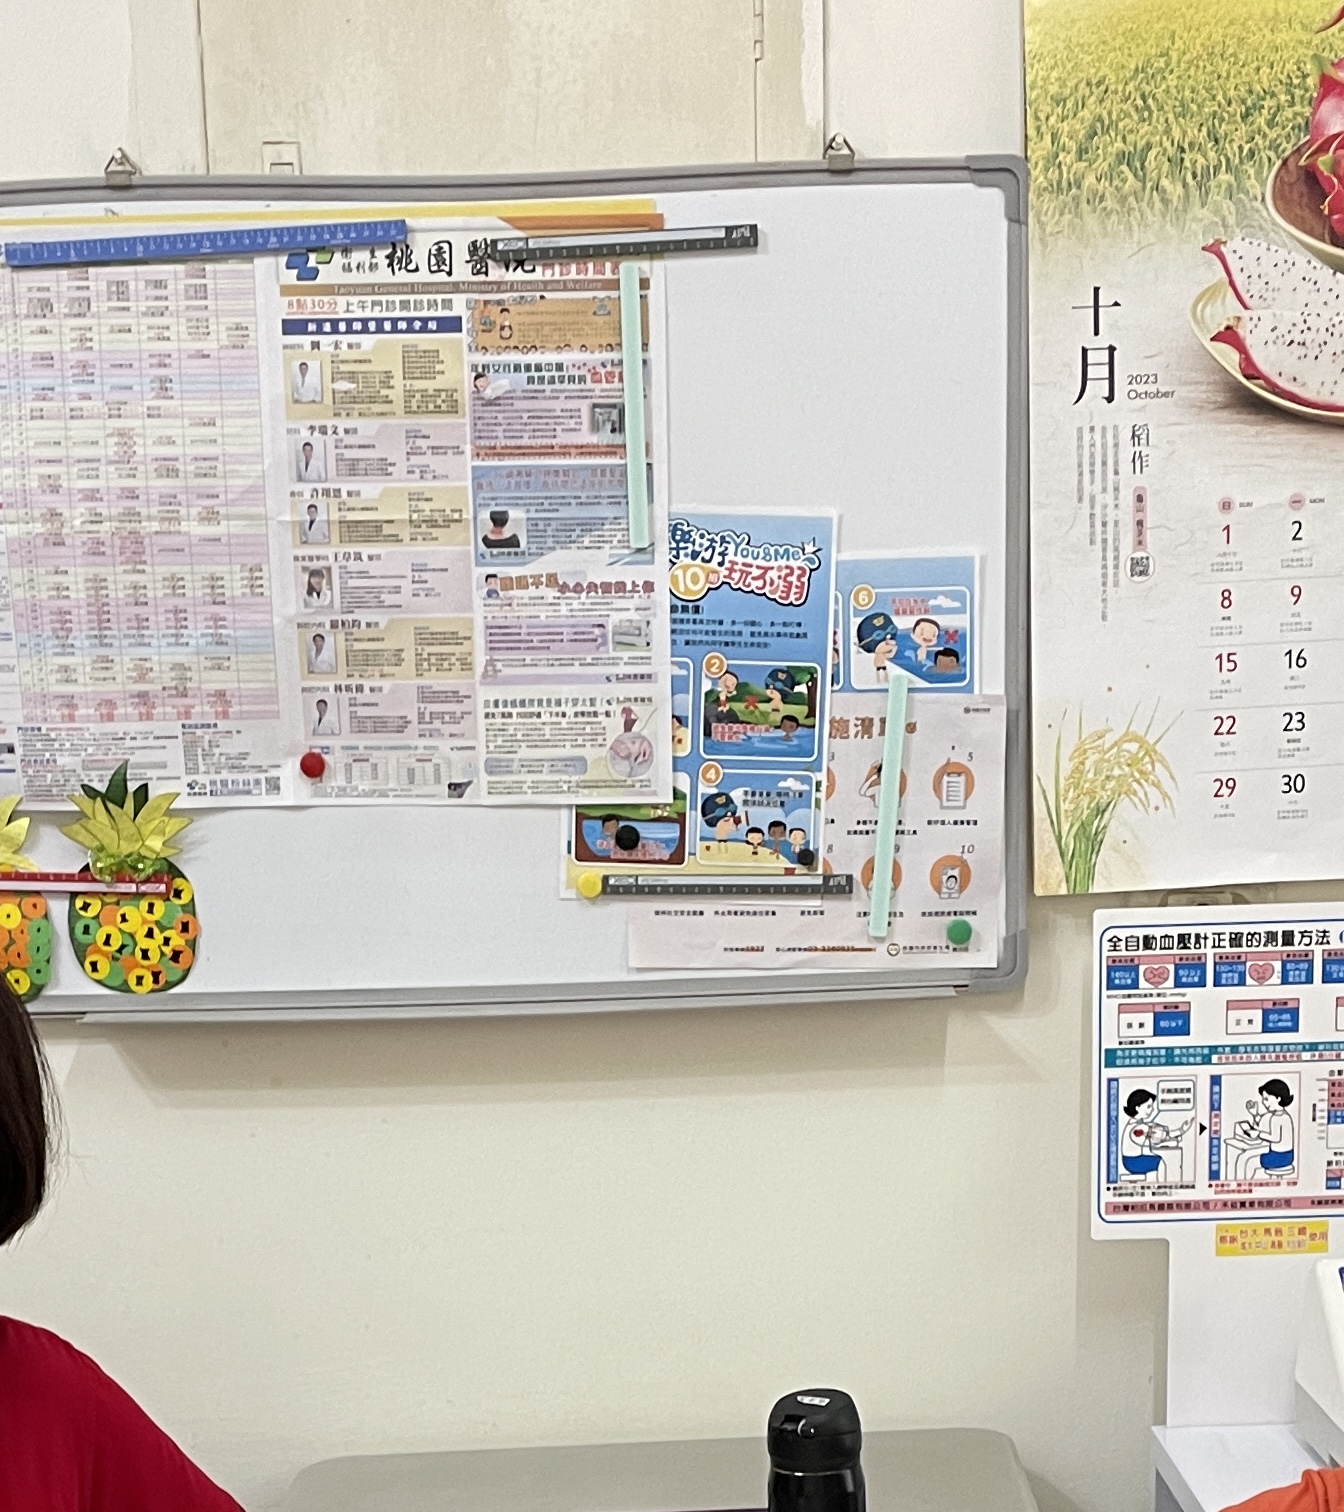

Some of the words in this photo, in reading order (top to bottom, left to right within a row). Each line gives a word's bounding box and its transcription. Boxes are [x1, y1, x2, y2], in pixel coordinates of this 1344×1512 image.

[374, 282, 412, 294] General
[458, 281, 504, 294] Ministry
[514, 280, 547, 292] Health
[549, 281, 565, 291] and
[566, 279, 603, 291] Welfare
[1071, 285, 1123, 406] 十月
[1126, 373, 1158, 386] 2023
[1126, 387, 1177, 401] October
[1221, 524, 1230, 545] 1
[1291, 520, 1303, 541] 2
[723, 559, 808, 602] 玩不溺
[858, 590, 869, 606] 6
[1220, 588, 1233, 610] 8
[1290, 585, 1302, 606] 9
[710, 658, 721, 673] 2
[1215, 652, 1238, 673] 15
[1284, 648, 1308, 669] 16
[1213, 715, 1237, 736] 22
[1282, 711, 1306, 732] 23
[705, 766, 717, 782] 4
[1213, 777, 1237, 798] 29
[1281, 773, 1306, 794] 30
[960, 844, 975, 854] 10
[1106, 928, 1332, 953] 全自動血壓計正確的測量方法
